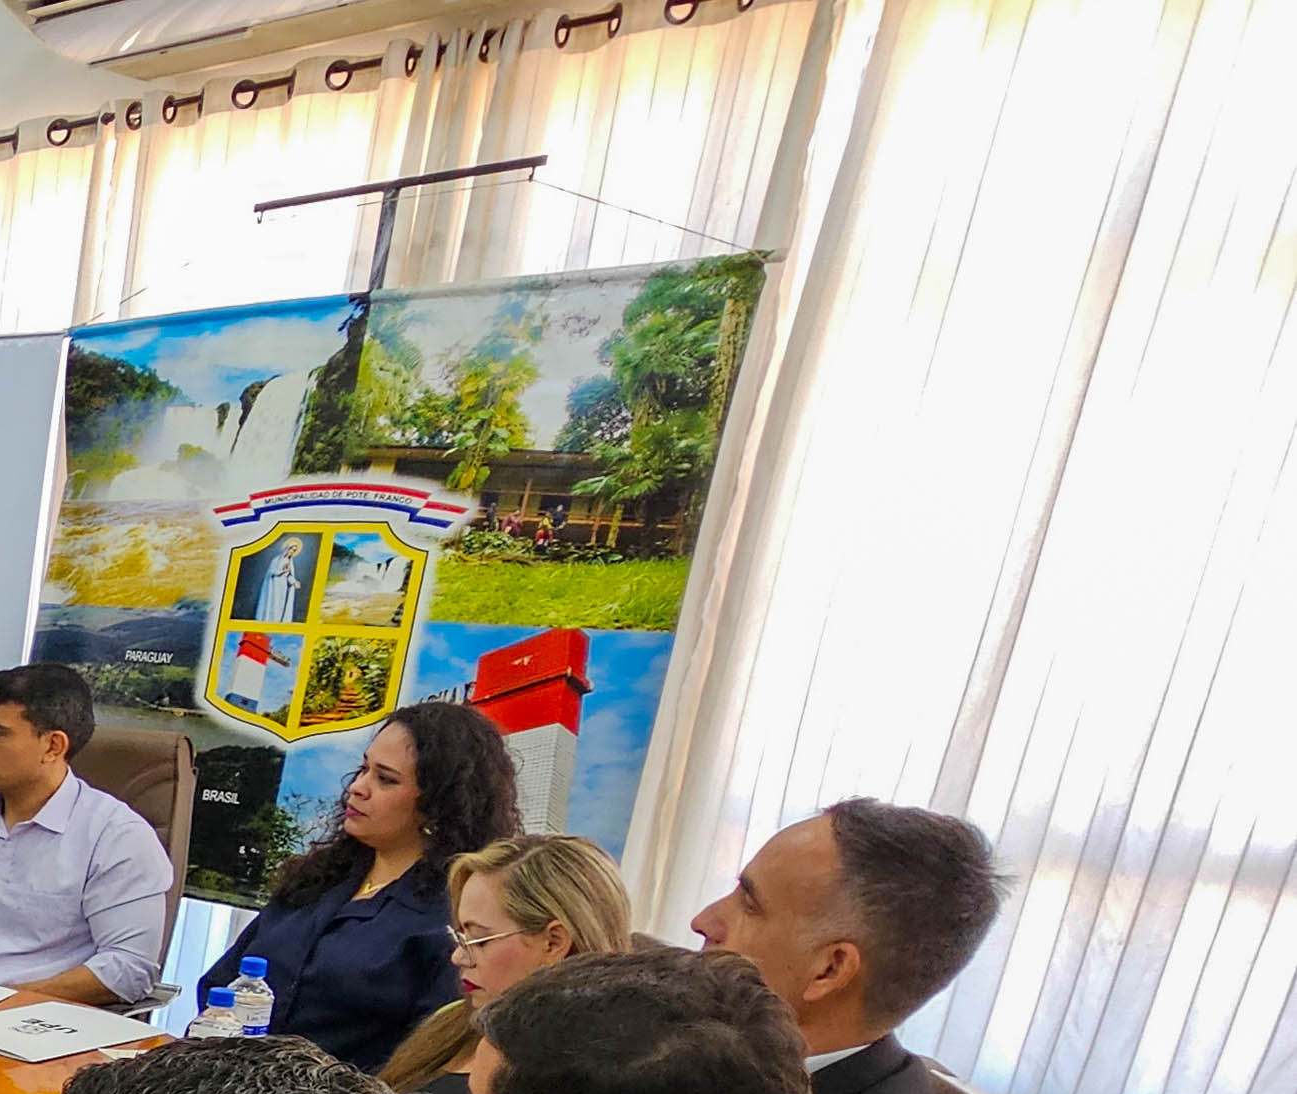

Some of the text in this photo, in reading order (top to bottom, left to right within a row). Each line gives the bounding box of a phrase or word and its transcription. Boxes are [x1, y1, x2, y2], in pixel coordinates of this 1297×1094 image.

[264, 491, 331, 505] MUNICIPALIDAD
[332, 490, 343, 498] DE
[374, 493, 413, 505] FRANCO
[124, 650, 174, 664] PARAGUAY
[201, 789, 241, 805] BRASIL
[20, 1018, 78, 1034] UPE
